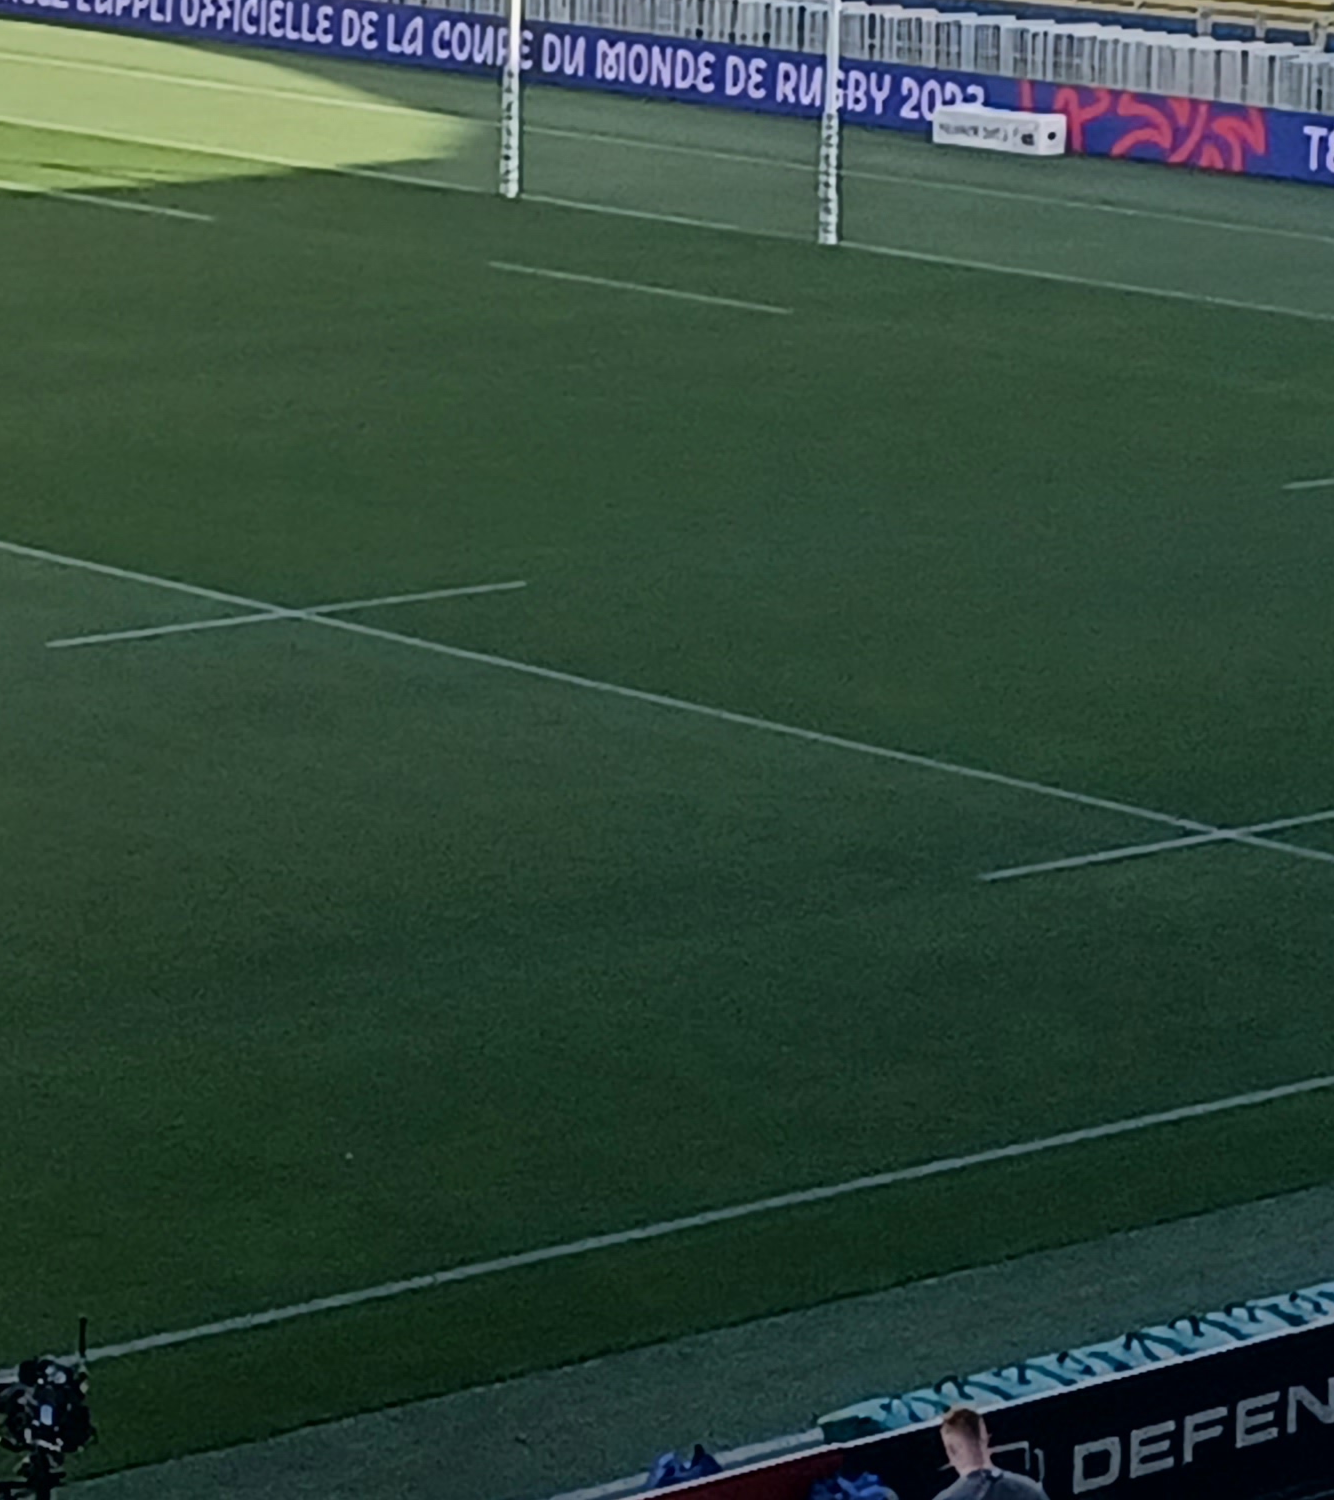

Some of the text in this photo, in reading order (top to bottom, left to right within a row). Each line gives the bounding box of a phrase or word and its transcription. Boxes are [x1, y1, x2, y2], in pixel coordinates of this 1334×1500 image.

[341, 7, 379, 50] DE
[386, 13, 424, 57] LA
[541, 32, 587, 78] DU
[595, 38, 717, 94] MONDE
[724, 54, 768, 99] DE
